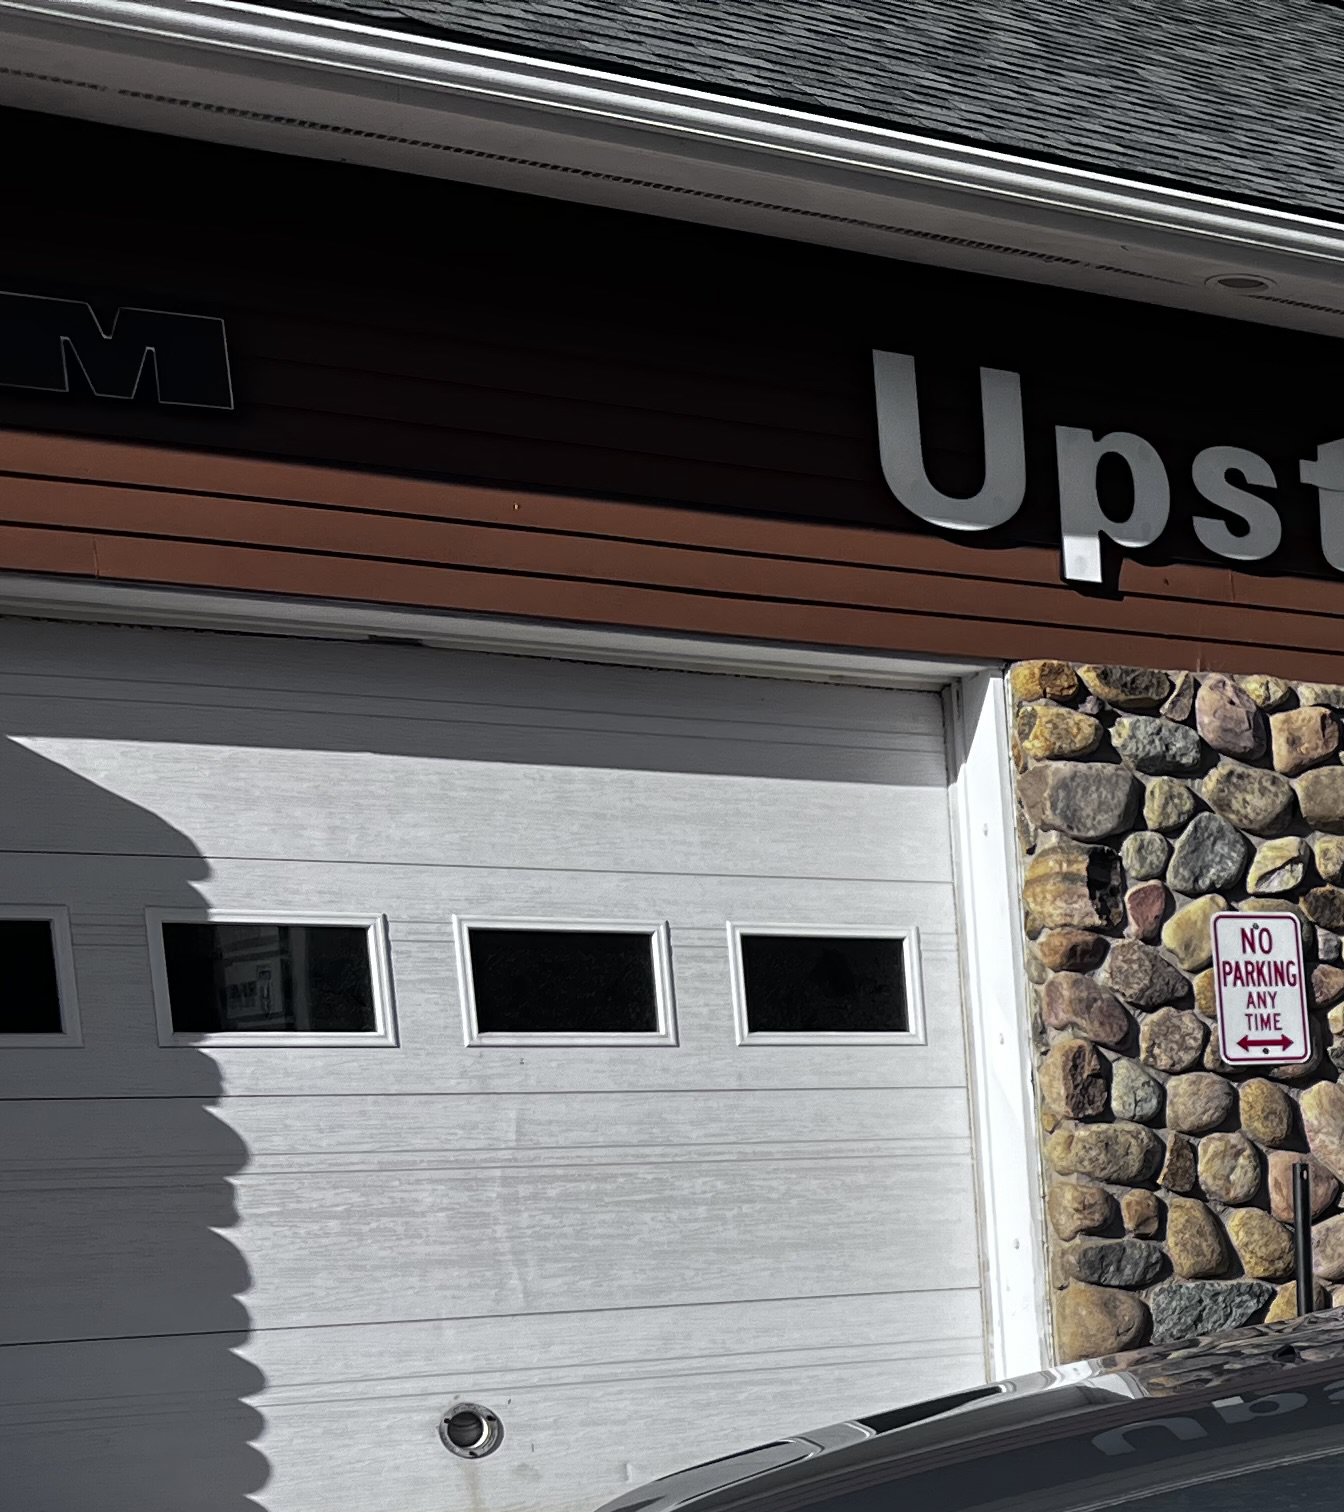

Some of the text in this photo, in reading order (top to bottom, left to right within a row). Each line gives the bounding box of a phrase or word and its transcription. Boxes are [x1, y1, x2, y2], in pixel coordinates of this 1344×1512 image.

[1240, 927, 1273, 955] NO
[1222, 960, 1297, 987] PARKING
[1246, 991, 1278, 1009] ANY
[1245, 1013, 1283, 1031] TIME
